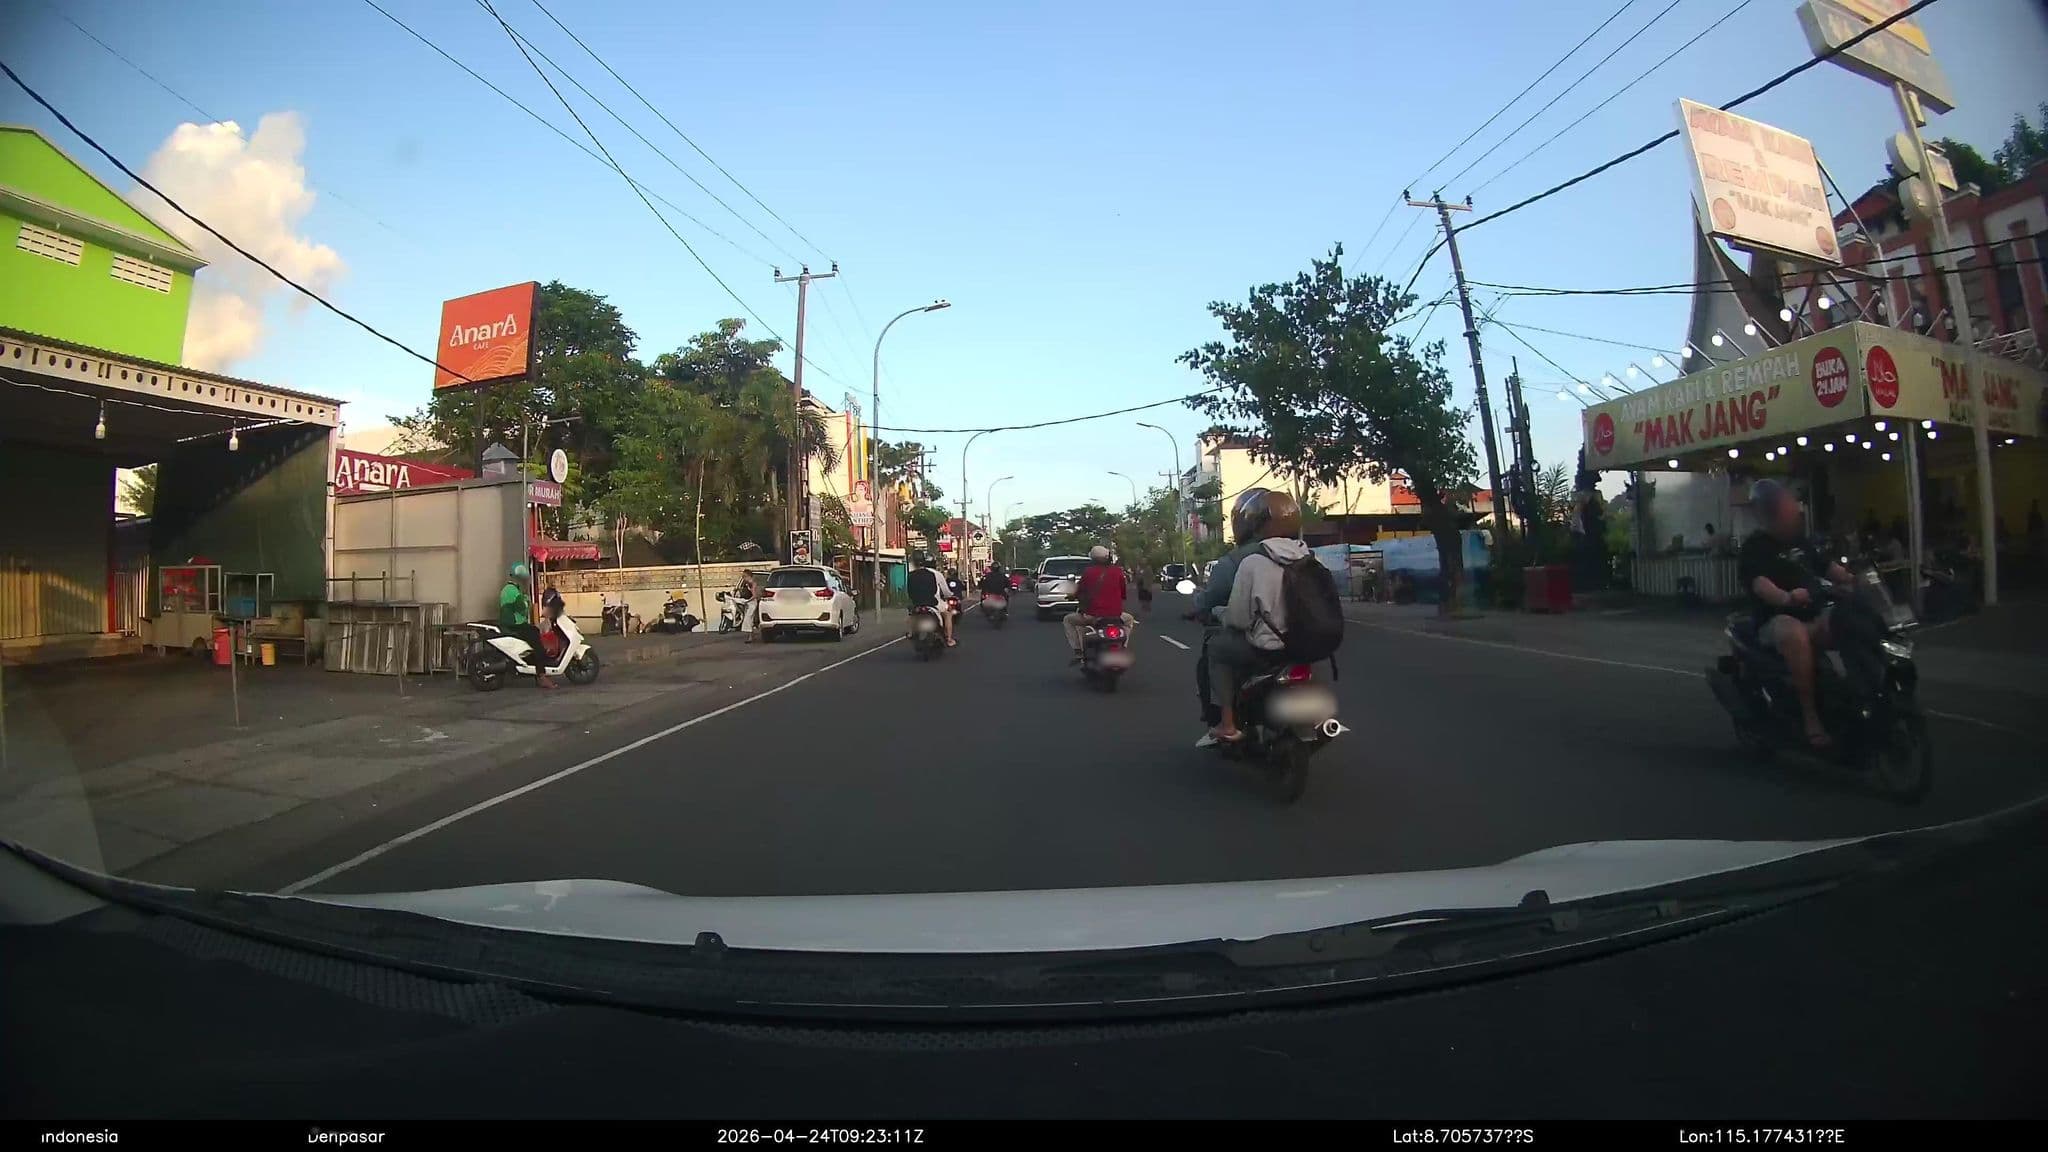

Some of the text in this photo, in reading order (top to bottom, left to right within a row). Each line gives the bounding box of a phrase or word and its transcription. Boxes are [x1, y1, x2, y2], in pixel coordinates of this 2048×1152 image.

[1723, 353, 1800, 394] REMPAH
[1815, 357, 1845, 378] BUKA
[1635, 385, 1780, 452] "MAK JANG"
